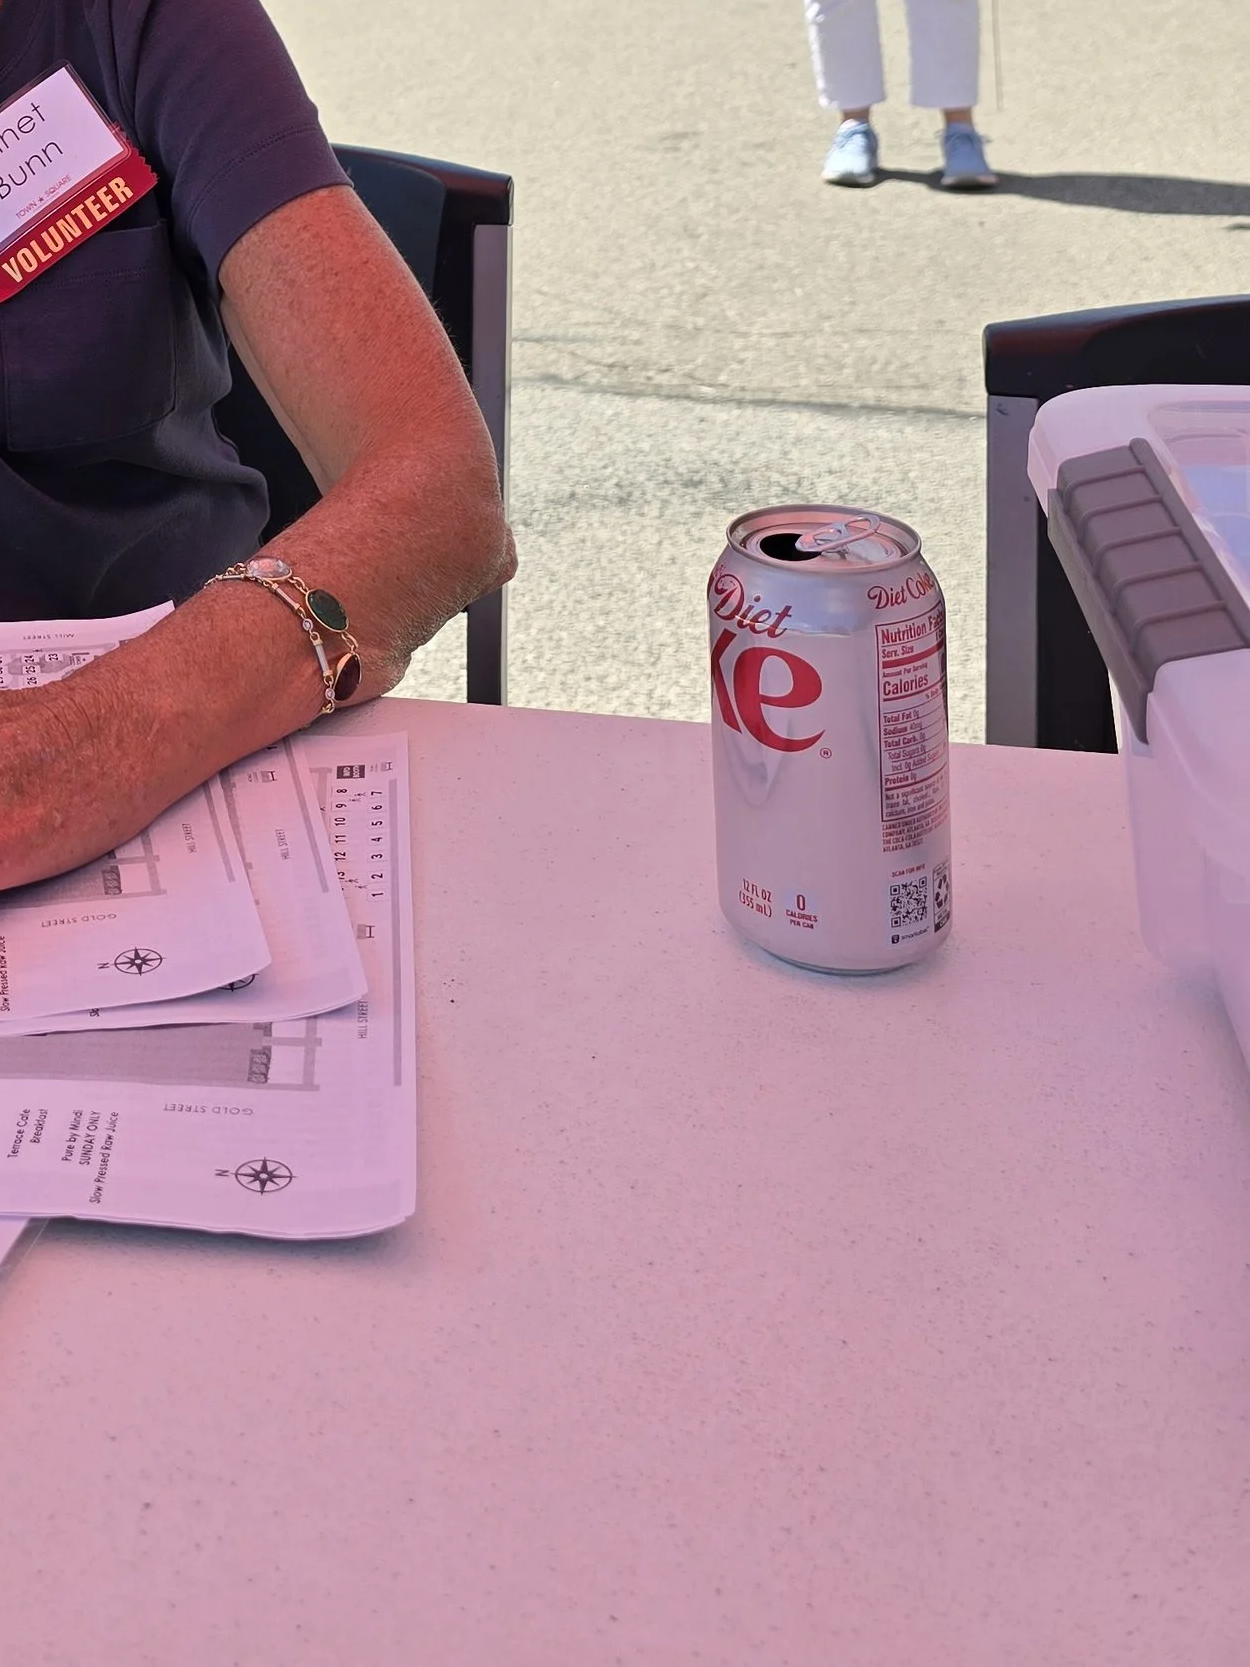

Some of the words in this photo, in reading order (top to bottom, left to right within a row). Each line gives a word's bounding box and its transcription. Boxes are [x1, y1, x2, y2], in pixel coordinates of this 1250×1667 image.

[15, 200, 37, 219] TOWN
[44, 174, 72, 197] SQUARE
[1, 176, 134, 283] VOLUNTEER
[867, 585, 907, 610] Diet
[906, 572, 934, 599] Coke
[714, 573, 793, 639] Diet
[881, 622, 927, 644] Nutrition
[48, 653, 59, 661] 23
[882, 649, 900, 659] Serv.
[901, 645, 914, 655] Size
[883, 674, 929, 696] Calories
[883, 715, 900, 723] Total
[901, 712, 911, 721] Fat
[883, 726, 908, 736] Sodium
[884, 738, 901, 748] Total
[884, 774, 909, 786] Protein
[334, 817, 346, 826] 10
[181, 823, 194, 841] STREET
[275, 828, 289, 847] STREET
[335, 834, 346, 843] 11
[334, 851, 347, 861] 12
[738, 890, 754, 909] (355
[742, 878, 750, 893] 12
[751, 883, 759, 898] FL
[761, 888, 772, 903] OZ
[796, 894, 806, 911] 0
[41, 916, 78, 928] STREET
[81, 913, 117, 923] GOLD
[0, 997, 10, 1012] Slow
[357, 1000, 368, 1023] STREET
[357, 1025, 368, 1039] HILL
[163, 1103, 207, 1113] STREET
[212, 1105, 254, 1116] GOLD
[30, 1109, 48, 1144] Breakfast
[69, 1109, 83, 1131] Mindi
[86, 1110, 101, 1131] ONLY
[105, 1111, 119, 1132] Juice
[7, 1129, 25, 1158] Terrace
[16, 1108, 31, 1127] Cafe
[66, 1132, 80, 1143] by
[79, 1132, 96, 1166] SUNDAY
[100, 1134, 114, 1151] Raw
[61, 1144, 75, 1162] Pure
[93, 1152, 110, 1184] Pressed
[88, 1185, 102, 1204] Slow
